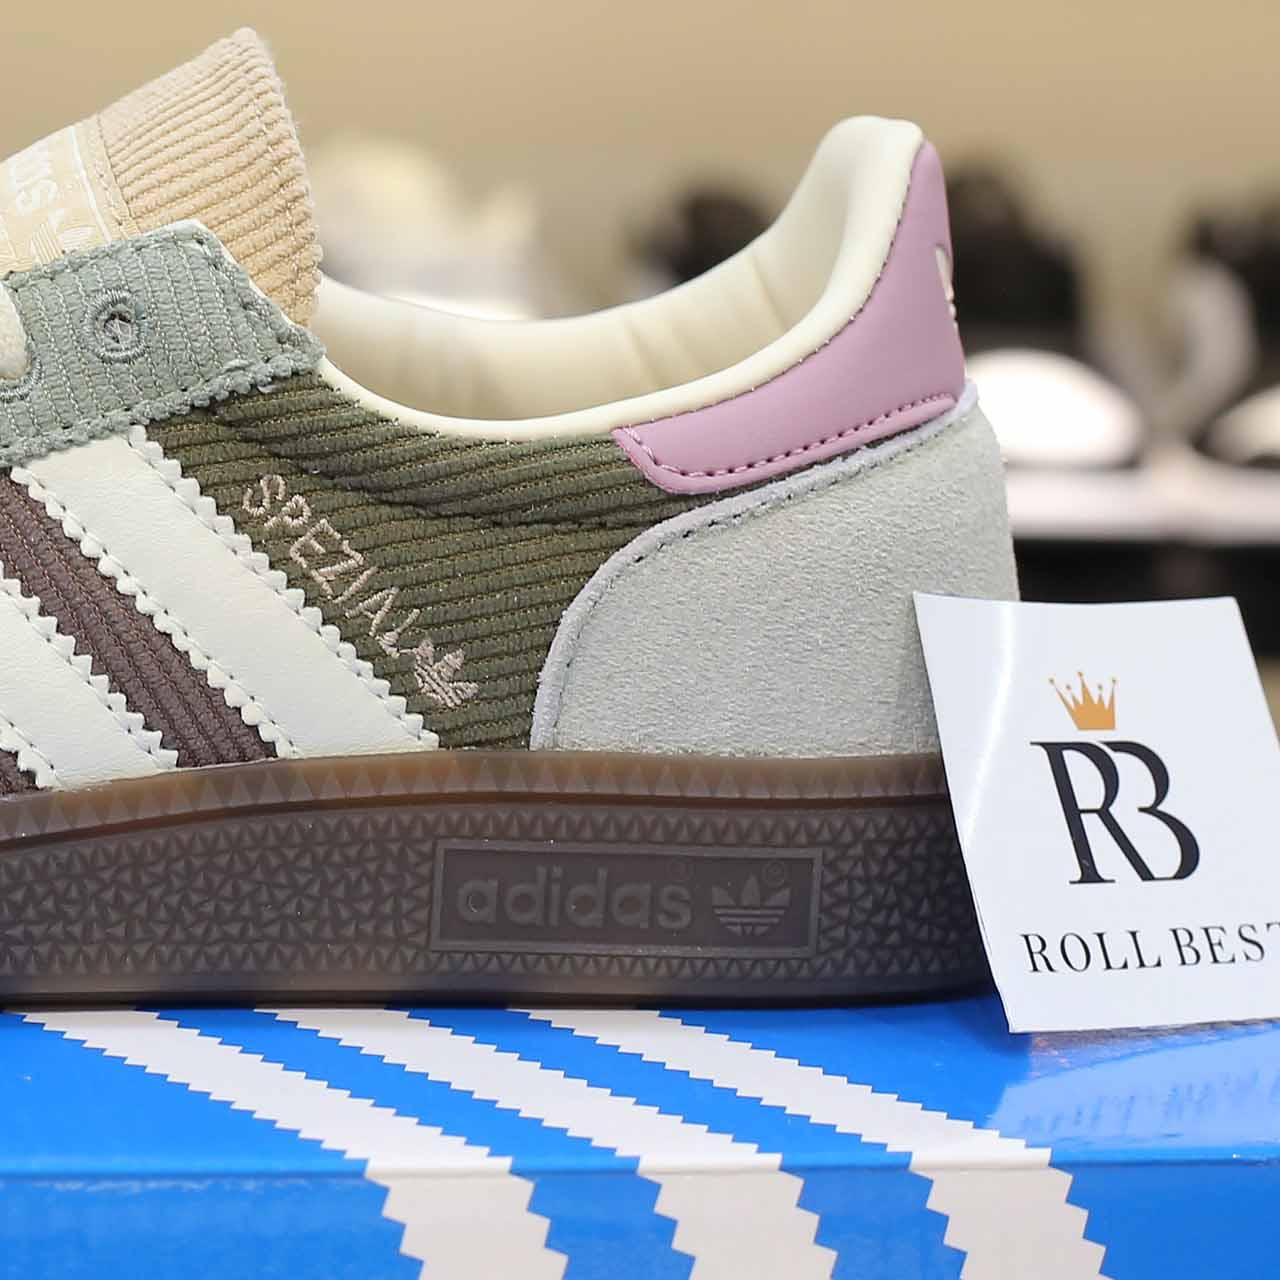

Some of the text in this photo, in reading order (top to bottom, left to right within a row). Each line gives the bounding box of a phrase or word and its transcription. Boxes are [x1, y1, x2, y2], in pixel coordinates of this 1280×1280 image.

[242, 474, 420, 658] SPEZIAL
[1029, 740, 1200, 885] RB
[455, 864, 693, 930] adidas
[1020, 930, 1162, 973] ROLL
